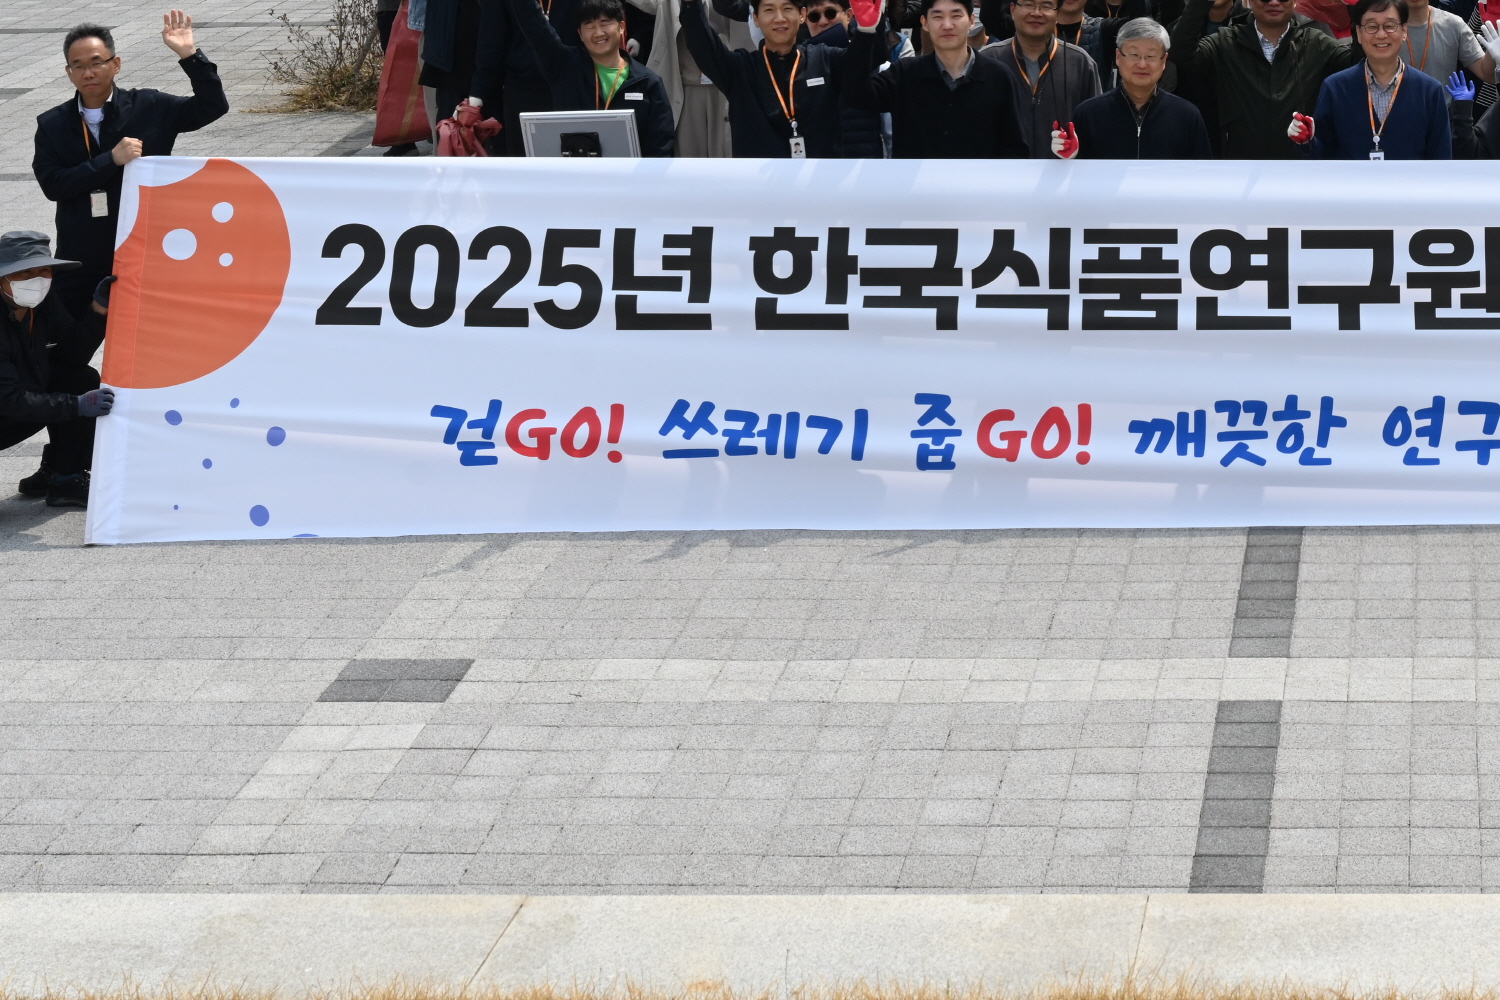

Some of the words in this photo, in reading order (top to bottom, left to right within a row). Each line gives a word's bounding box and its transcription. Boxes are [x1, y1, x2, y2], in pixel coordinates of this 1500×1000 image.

[316, 223, 714, 331] 2025년
[430, 399, 625, 467] 걷GO!
[658, 398, 869, 462] 쓰레기
[1128, 394, 1348, 468] 깨끗한
